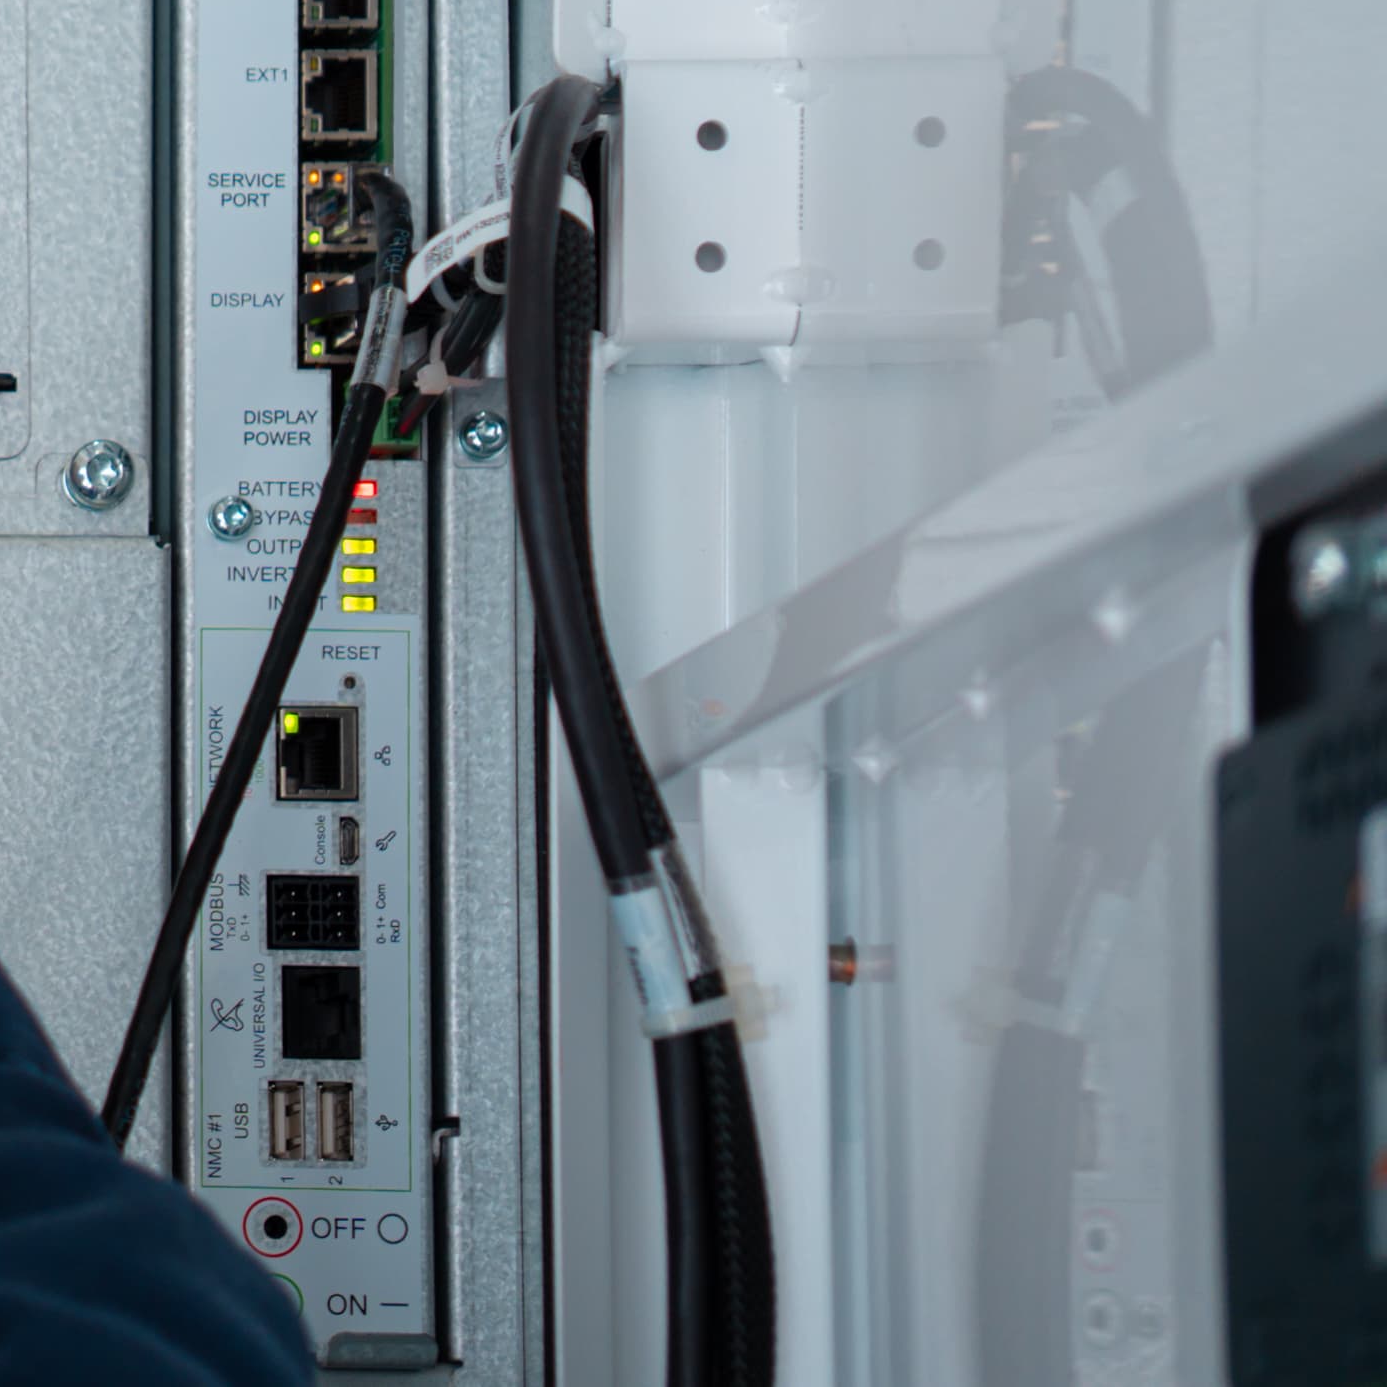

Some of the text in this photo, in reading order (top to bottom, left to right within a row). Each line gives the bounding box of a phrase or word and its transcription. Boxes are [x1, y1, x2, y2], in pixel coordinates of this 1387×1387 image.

[245, 68, 289, 82] EXT1
[207, 172, 285, 188] SERVICE
[221, 192, 271, 207] PORT
[211, 292, 285, 308] DISPLAY
[243, 410, 319, 425] DISPLAY
[243, 431, 311, 446] POWER
[253, 510, 314, 526] BYPAS
[247, 538, 302, 555] OUTP
[321, 646, 381, 660] RESET
[209, 705, 224, 789] ETWORK
[315, 815, 325, 864] Console
[377, 884, 386, 910] Com
[209, 872, 225, 952] MODBUS
[227, 917, 236, 938] TxD
[391, 919, 400, 943] RxD
[253, 962, 265, 1069] UNIVERSAL I/O
[235, 1102, 249, 1140] USB
[208, 1113, 221, 1178] NMC #1
[329, 1176, 343, 1185] 2
[311, 1218, 365, 1240] OFF
[327, 1294, 367, 1315] ON
